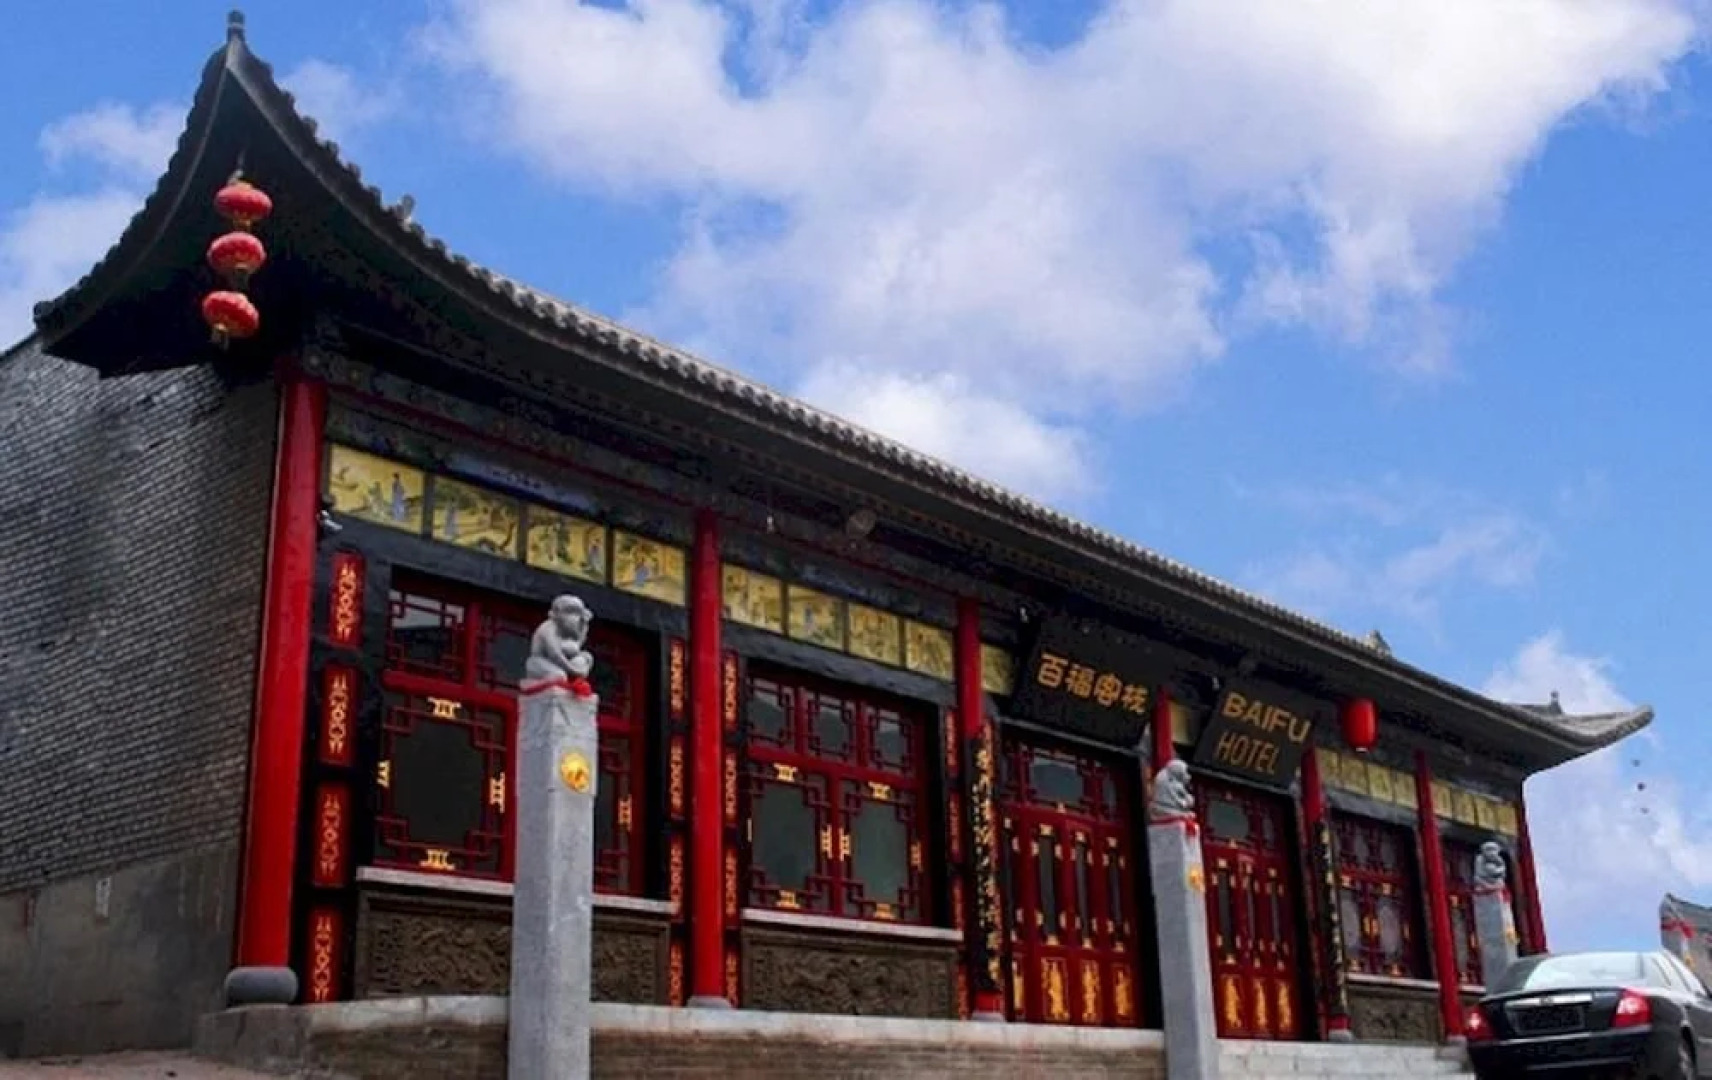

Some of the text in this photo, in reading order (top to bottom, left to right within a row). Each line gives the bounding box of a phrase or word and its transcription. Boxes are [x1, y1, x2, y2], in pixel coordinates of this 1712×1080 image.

[1037, 653, 1149, 714] 百福客栈
[1223, 693, 1310, 741] BAIFU
[1217, 731, 1280, 774] HOTEL
